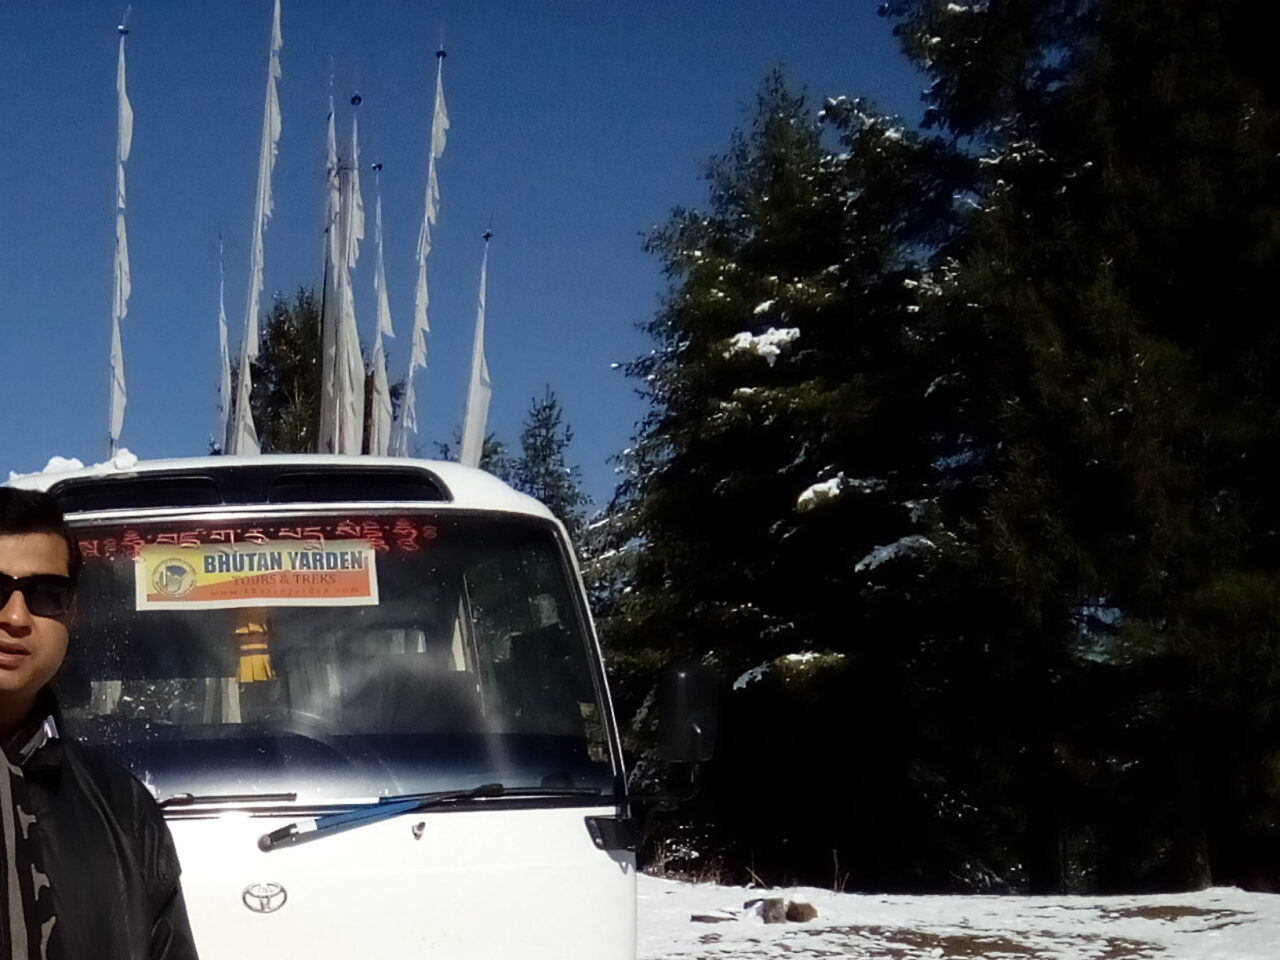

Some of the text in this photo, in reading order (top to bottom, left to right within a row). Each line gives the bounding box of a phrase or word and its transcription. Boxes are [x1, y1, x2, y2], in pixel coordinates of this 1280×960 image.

[204, 550, 362, 573] BHUTAN YARDEN
[231, 573, 336, 586] TOURS & TREKS
